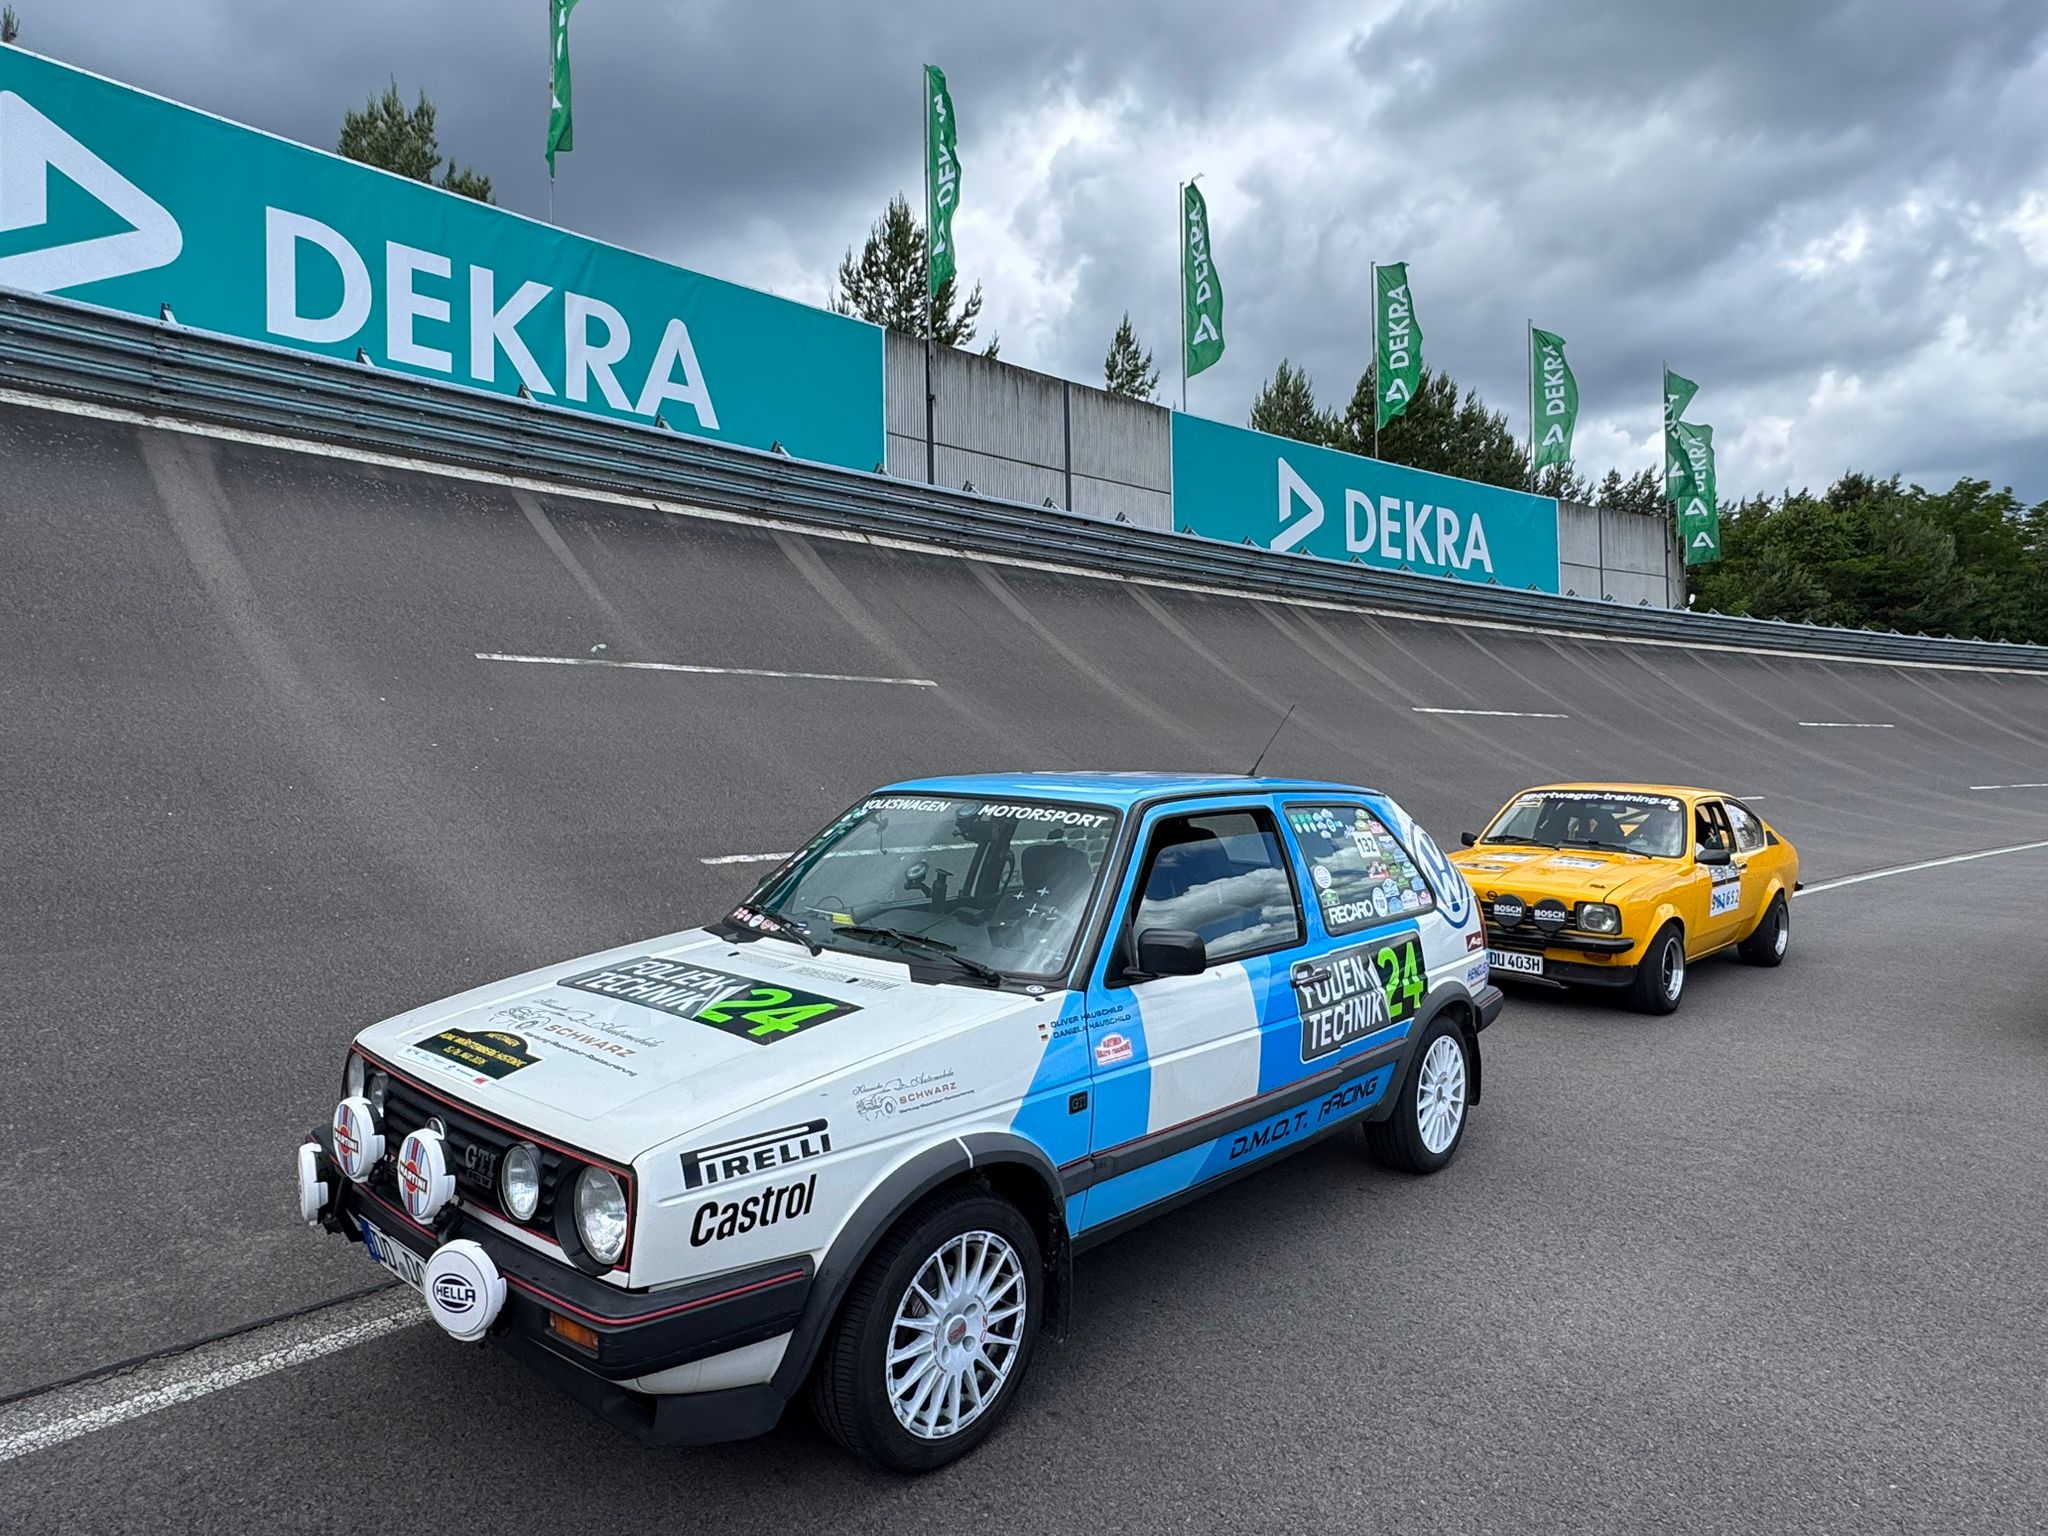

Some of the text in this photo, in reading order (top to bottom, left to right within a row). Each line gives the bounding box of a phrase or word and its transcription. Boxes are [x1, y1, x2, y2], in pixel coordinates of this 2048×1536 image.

[1190, 202, 1211, 305] DEKRA
[266, 205, 720, 430] DEKRA
[1387, 284, 1411, 369] DEKRA
[1543, 345, 1566, 416] DEKRA
[1345, 488, 1493, 573] DEKRA
[862, 798, 1108, 828] VOLKSWAGEN MOTORSPORT
[1521, 791, 1679, 807] sportwagen-training.de
[1358, 837, 1377, 853] 132
[1328, 899, 1374, 926] RECARO
[1494, 904, 1522, 914] BOSCH
[1534, 909, 1566, 919] BOSCH
[617, 960, 737, 990] FOLIEN
[1490, 952, 1540, 972] DU 403H
[575, 971, 706, 1011] TECHNIK
[1377, 941, 1424, 1018] 24
[700, 988, 838, 1037] 24
[1050, 1015, 1079, 1028] OLIVER
[1309, 991, 1383, 1050] TECHNIK
[544, 1024, 637, 1058] SCHWARZ
[899, 1081, 957, 1104] SCHWARZ
[1071, 1095, 1088, 1110] GTI
[1229, 1075, 1379, 1160] D.M.O.T. RACING
[335, 1129, 358, 1152] MARTINI
[680, 1118, 832, 1190] PIRELLI
[400, 1162, 427, 1191] MARTINI
[465, 1143, 497, 1179] GTI
[689, 1173, 817, 1247] Castrol
[370, 1229, 398, 1272] DD
[435, 1282, 476, 1302] HELLA
